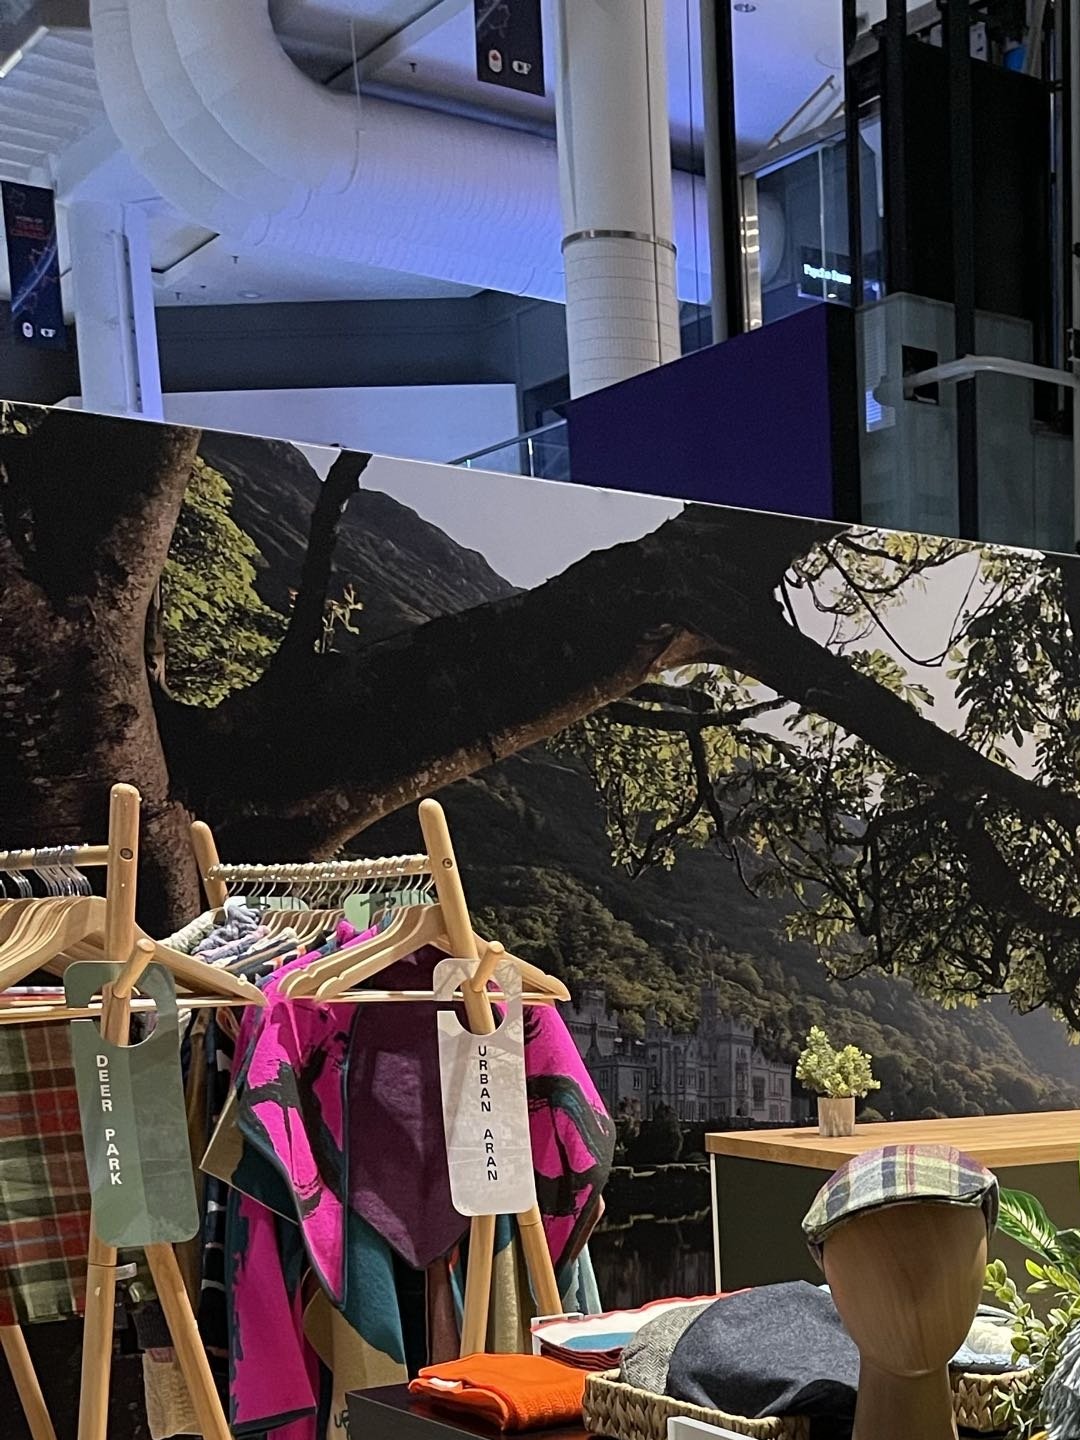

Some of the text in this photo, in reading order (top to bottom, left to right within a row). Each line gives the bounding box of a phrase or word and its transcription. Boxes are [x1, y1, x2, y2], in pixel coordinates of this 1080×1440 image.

[96, 1054, 122, 1185] DEER PARK
[478, 1045, 499, 1181] URBAN ARAN
